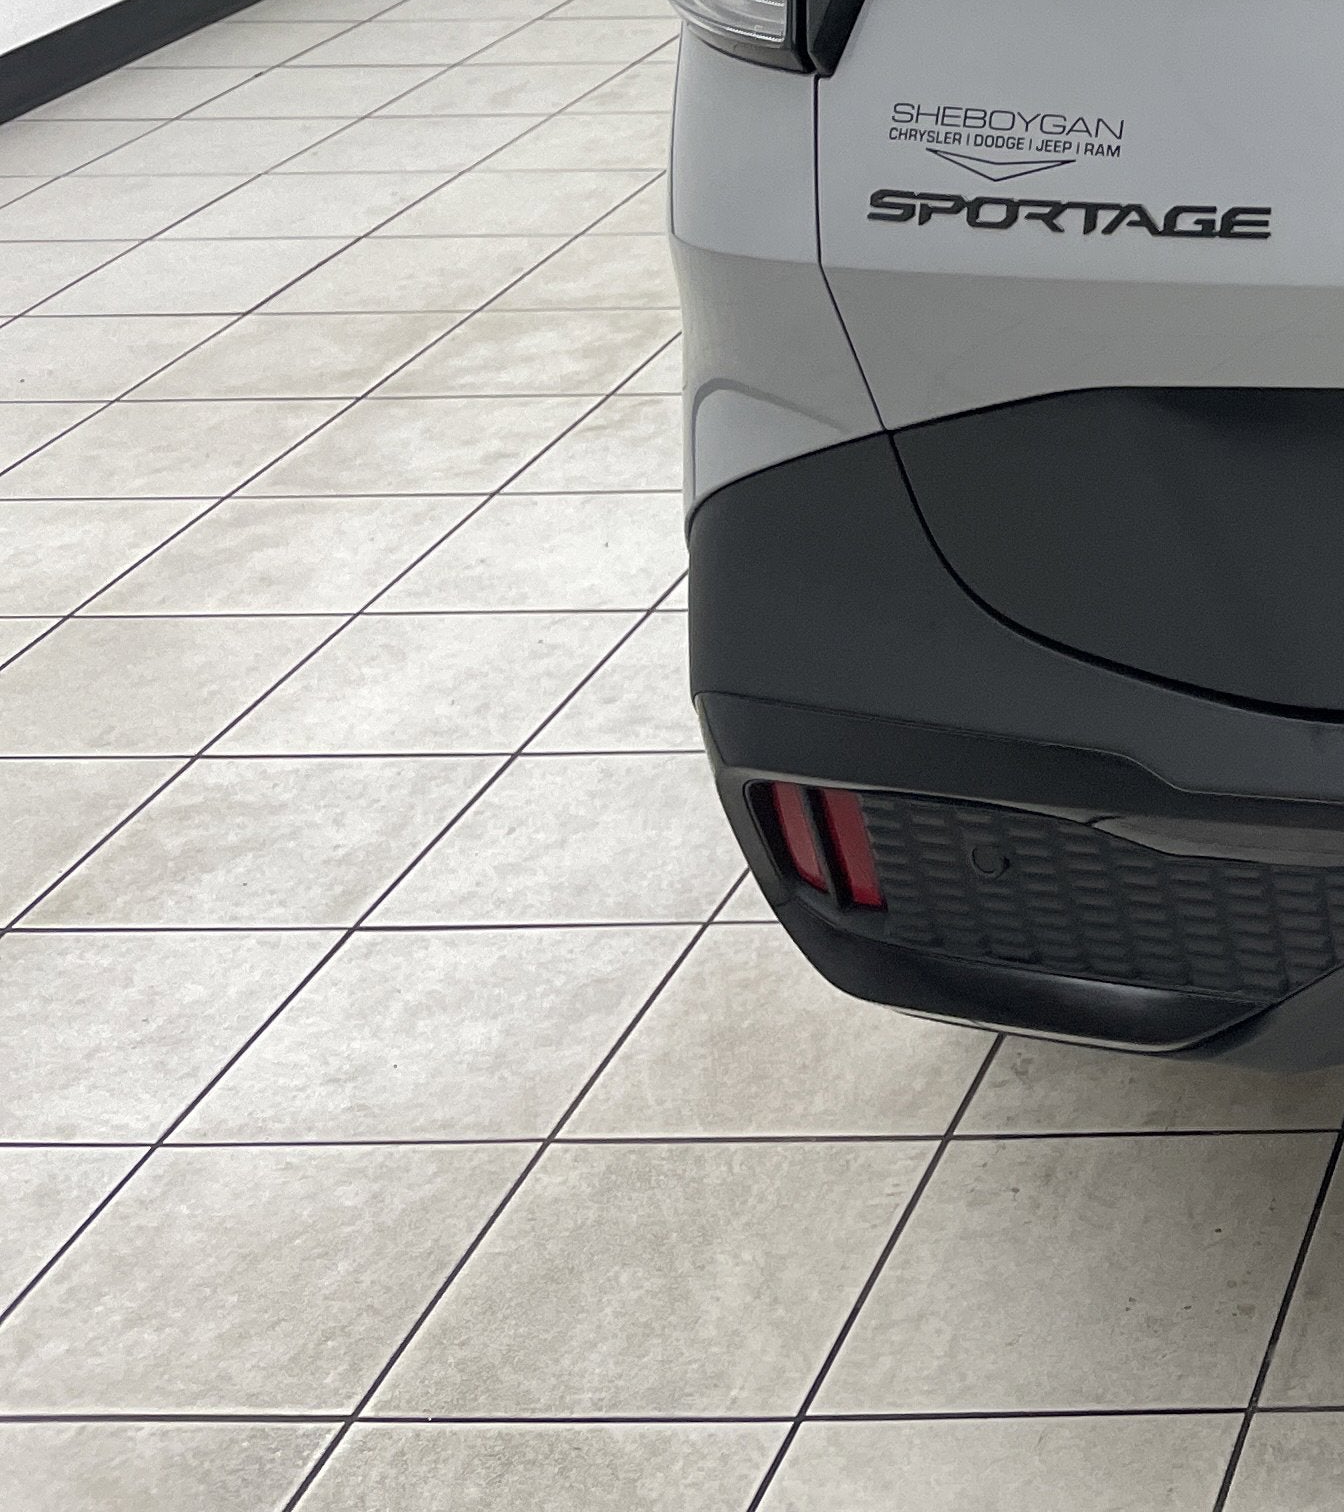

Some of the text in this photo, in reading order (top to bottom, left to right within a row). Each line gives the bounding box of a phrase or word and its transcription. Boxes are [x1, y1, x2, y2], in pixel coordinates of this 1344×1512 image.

[891, 102, 1125, 140] SHEBOYGAN
[888, 127, 1121, 158] CHRYSLER DODGE JEEP RAM
[867, 188, 1272, 240] SPORTAGE
